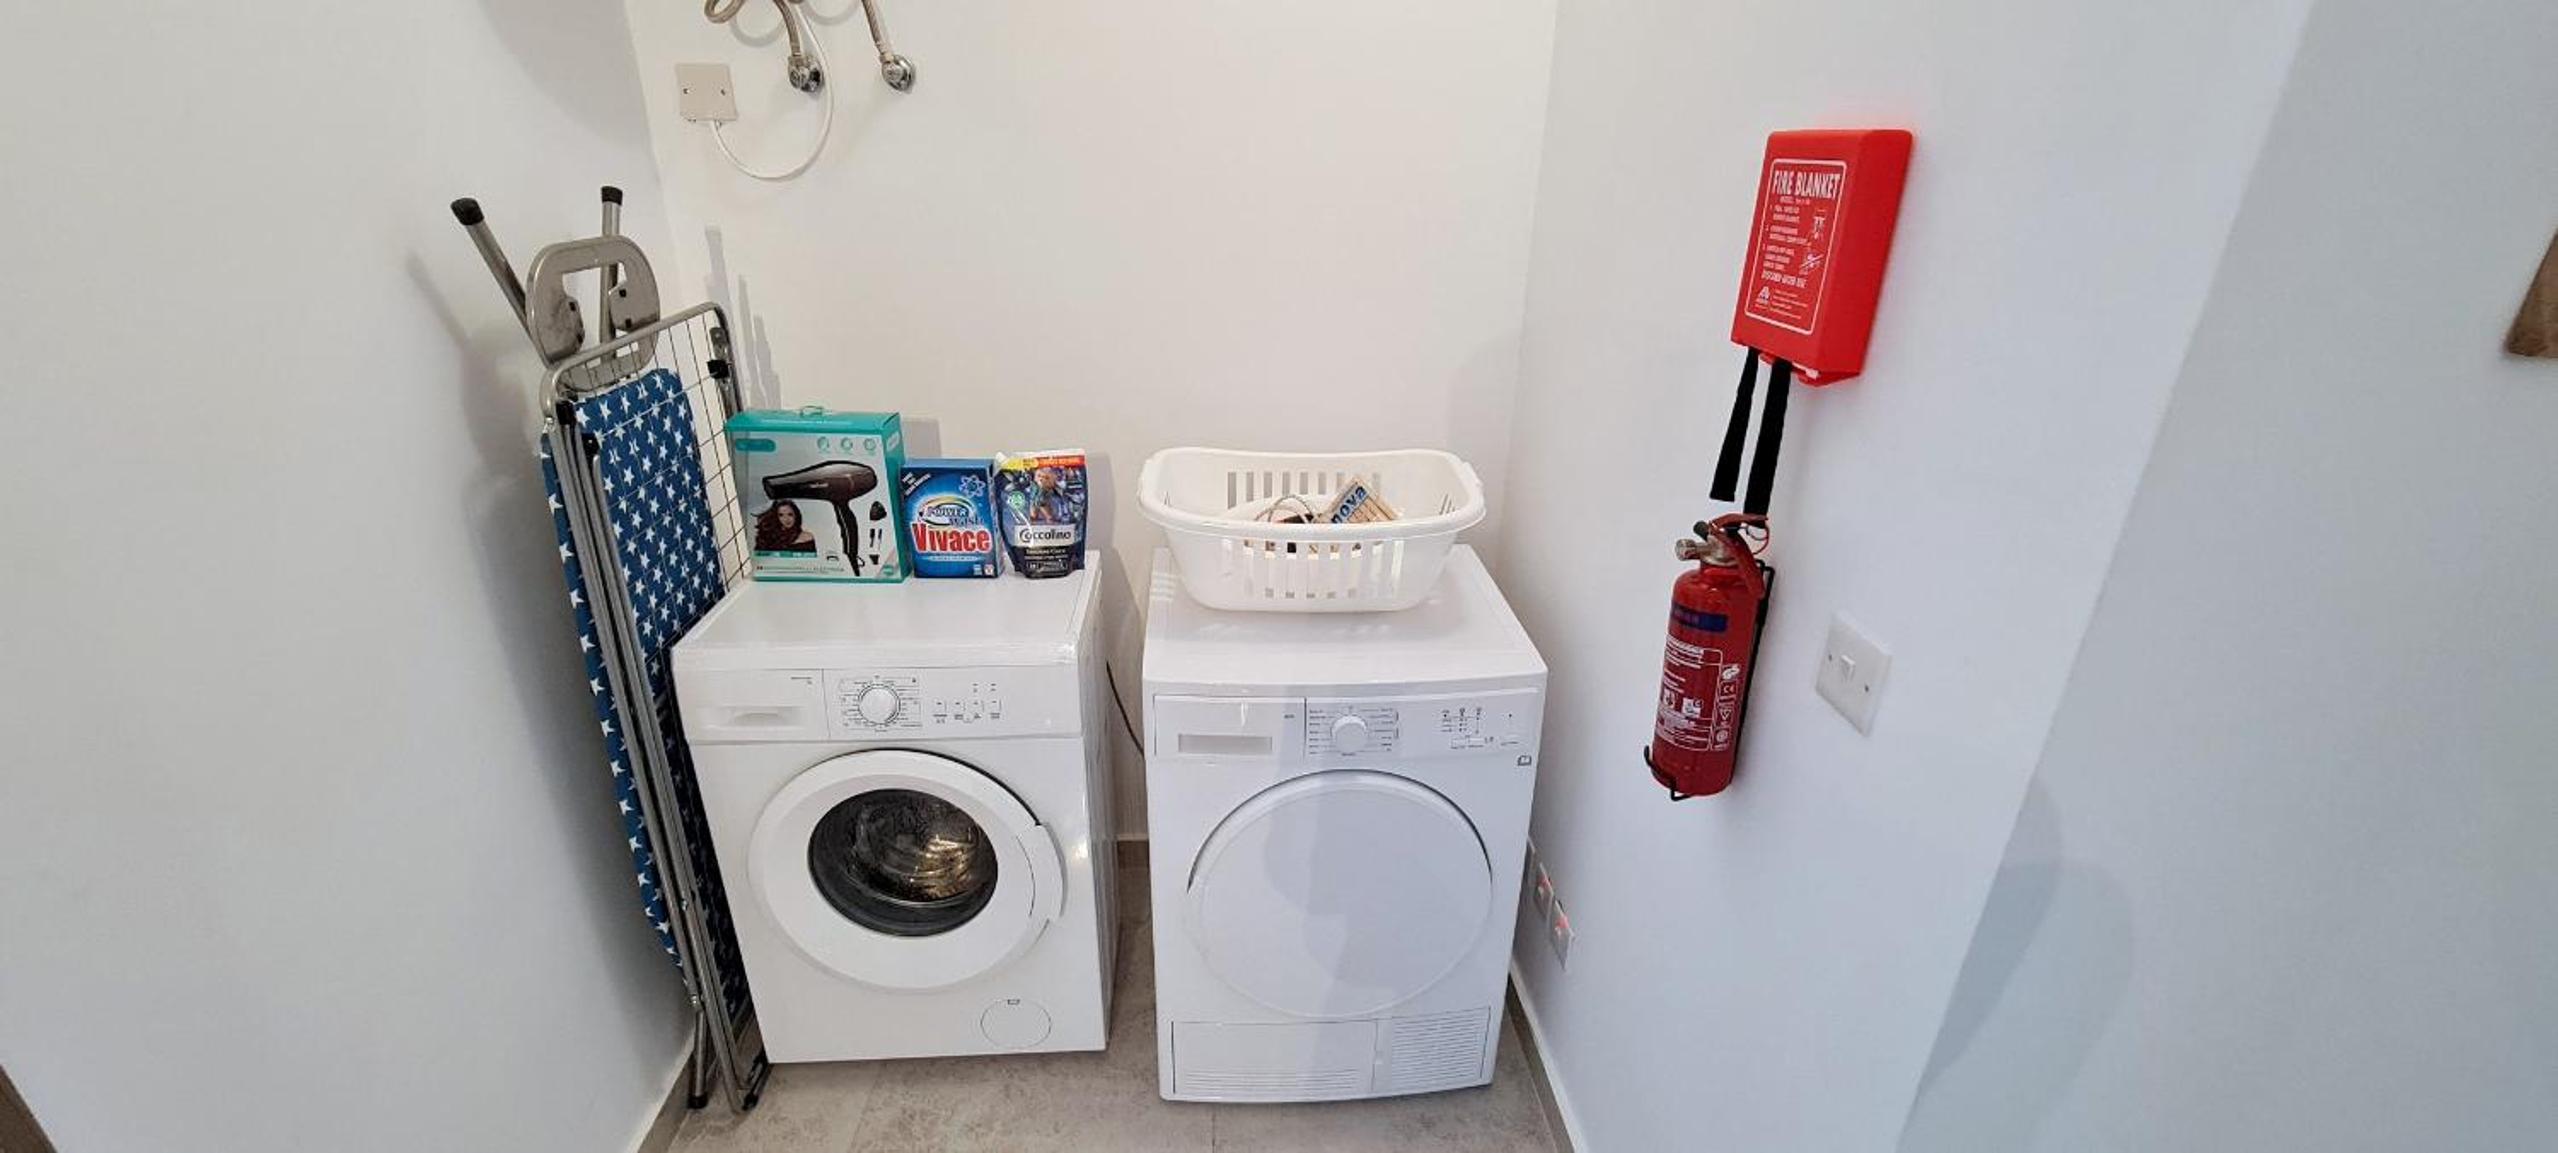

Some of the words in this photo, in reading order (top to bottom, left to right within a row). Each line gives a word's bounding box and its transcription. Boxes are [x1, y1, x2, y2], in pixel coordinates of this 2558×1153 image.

[1772, 170, 1795, 195] FIRE
[1794, 171, 1841, 199] BLANKET
[926, 505, 968, 518] POWER
[911, 522, 992, 553] Vivace
[1019, 528, 1072, 543] Coccolino
